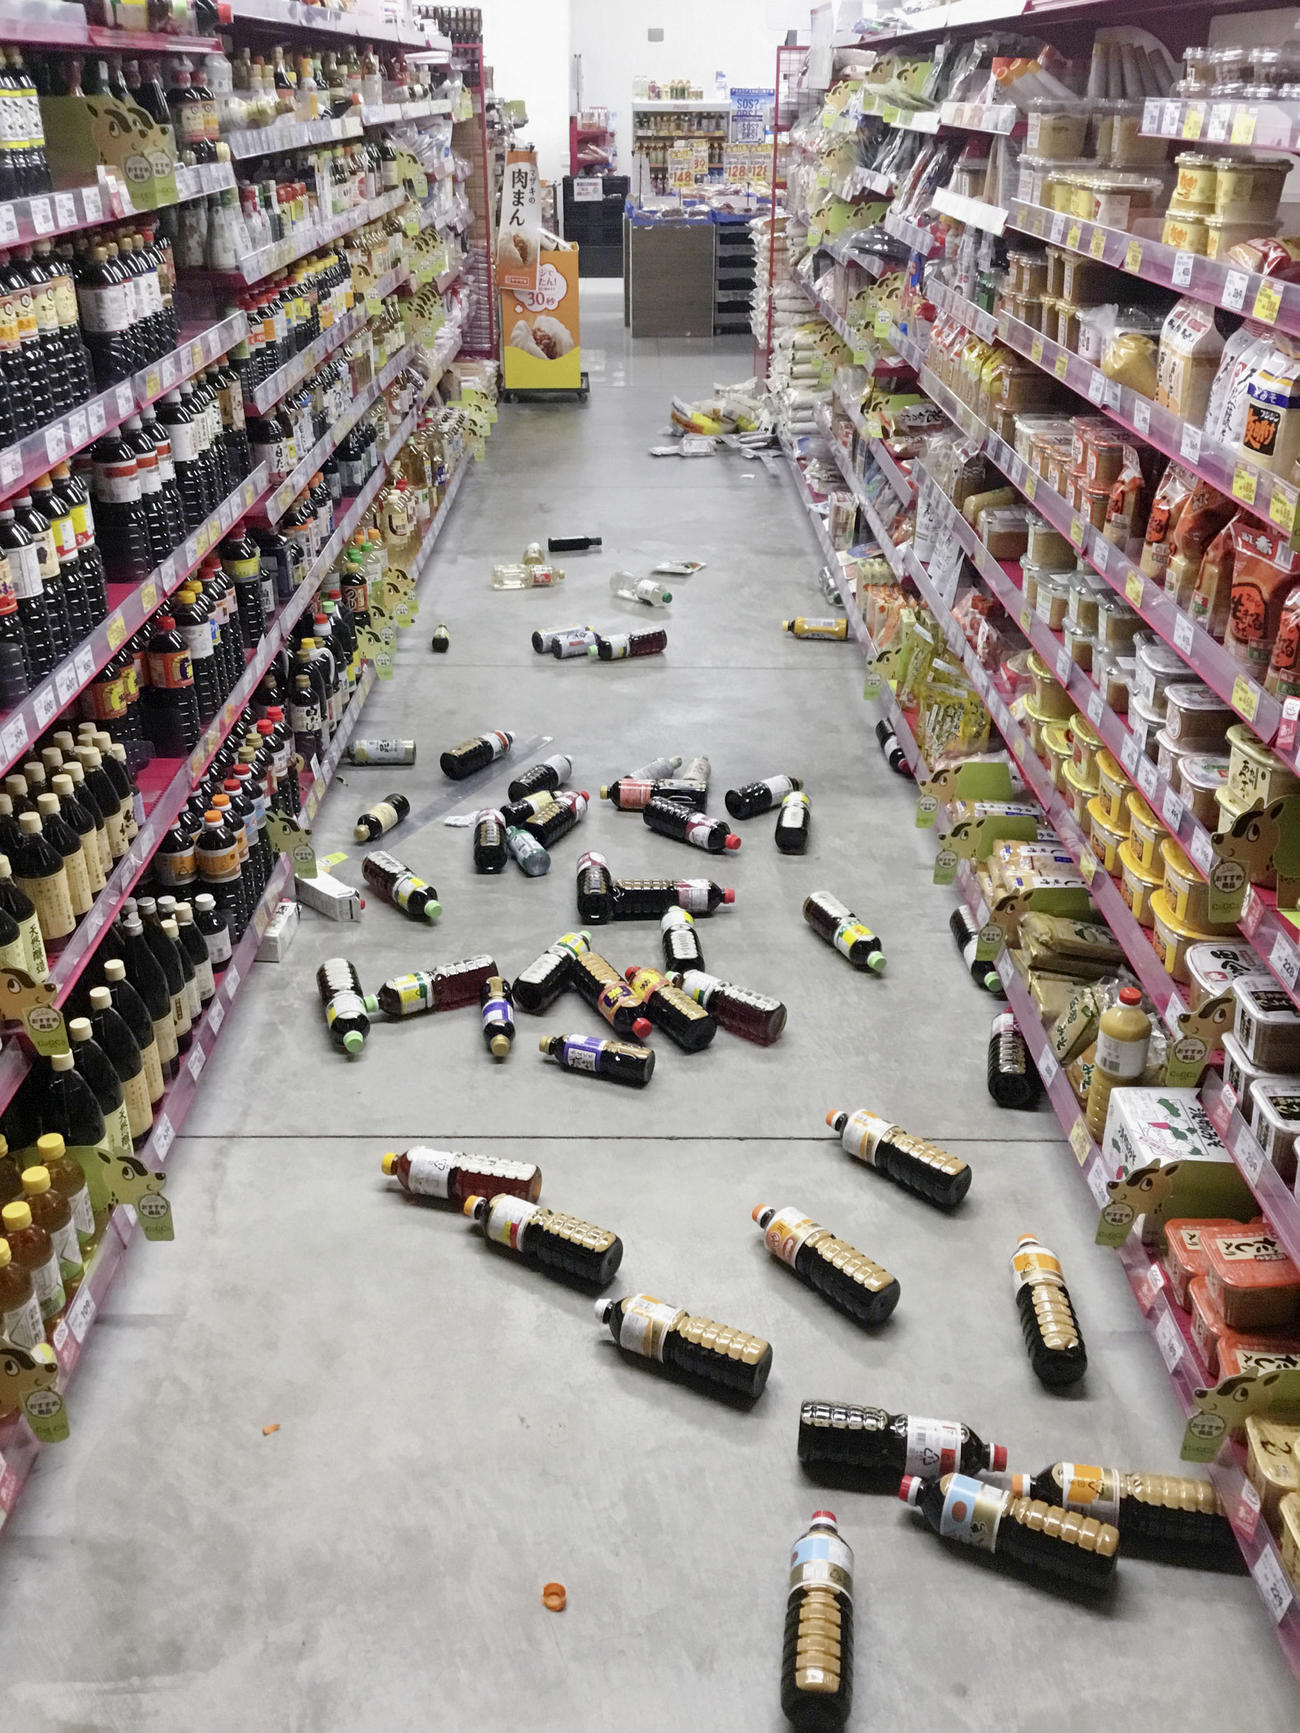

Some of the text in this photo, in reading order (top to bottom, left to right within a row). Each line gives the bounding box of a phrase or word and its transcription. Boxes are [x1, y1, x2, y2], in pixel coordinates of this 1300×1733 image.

[737, 98, 760, 109] SOS?
[728, 166, 746, 177] 128
[509, 168, 528, 226] 肉まん
[1216, 874, 1243, 882] おすすめ
